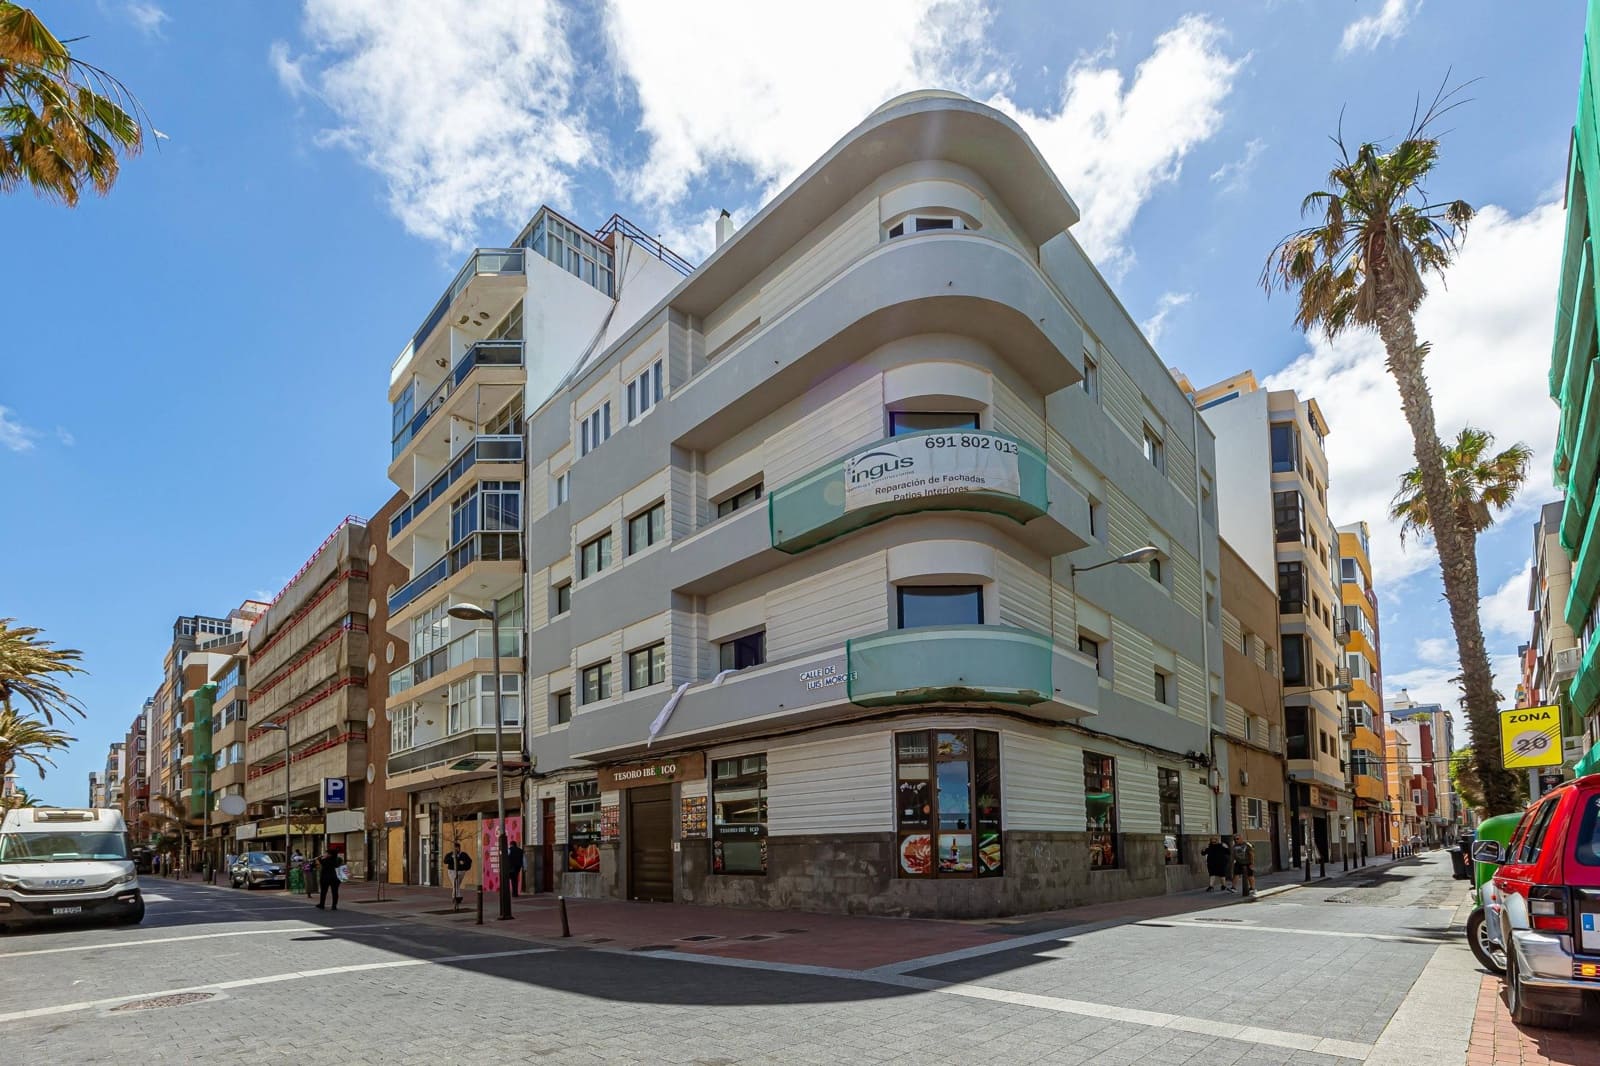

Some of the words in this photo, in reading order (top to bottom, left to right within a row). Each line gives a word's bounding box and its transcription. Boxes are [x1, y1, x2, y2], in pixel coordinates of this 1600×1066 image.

[925, 436, 957, 449] 691
[961, 436, 990, 449] 802
[994, 440, 1019, 455] 013
[851, 457, 914, 483] ingus
[875, 478, 926, 495] Reparación
[928, 474, 940, 484] de
[943, 474, 986, 484] Fachadas
[893, 489, 922, 501] Patios
[924, 486, 969, 497] Interiores
[800, 669, 822, 681] CALLE
[825, 665, 835, 675] DE
[807, 680, 823, 690] LUIS
[1509, 711, 1551, 723] ZONA
[1516, 737, 1548, 751] 20
[613, 769, 642, 781] TESORO
[327, 778, 344, 796] P
[45, 879, 86, 887] IVECO
